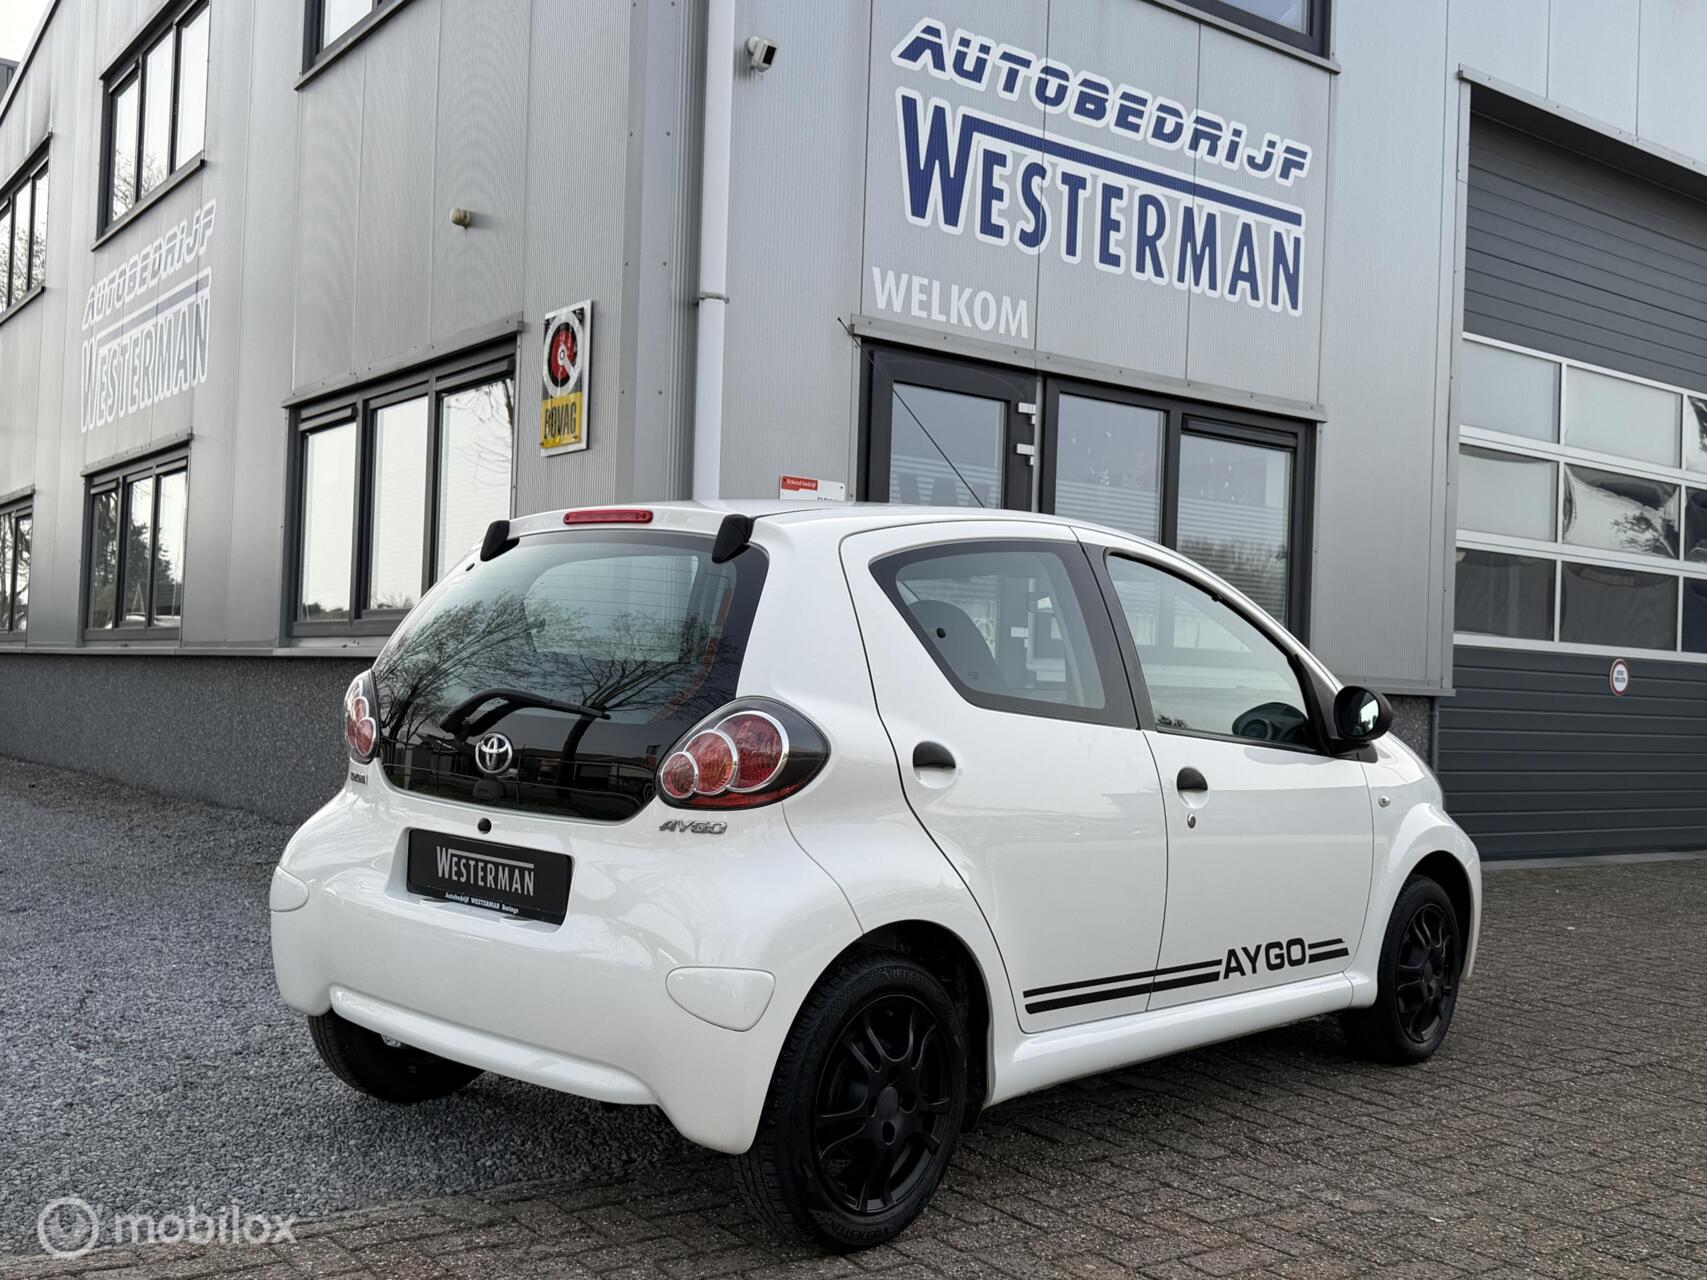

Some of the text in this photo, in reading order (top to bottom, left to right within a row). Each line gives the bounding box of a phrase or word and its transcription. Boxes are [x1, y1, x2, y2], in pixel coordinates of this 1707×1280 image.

[893, 20, 1311, 184] AUTOBEDRIJF
[899, 92, 1304, 312] WESTERMAN
[82, 198, 216, 331] AUTOBEDRIJF
[872, 266, 1029, 339] WELKOM
[81, 267, 212, 433] WESTERMAN
[544, 402, 577, 439] BOVAG
[659, 820, 728, 834] AYGO
[437, 846, 534, 896] WESTERMAN
[470, 897, 500, 909] WESTERMAN
[1223, 937, 1306, 980] AYGO
